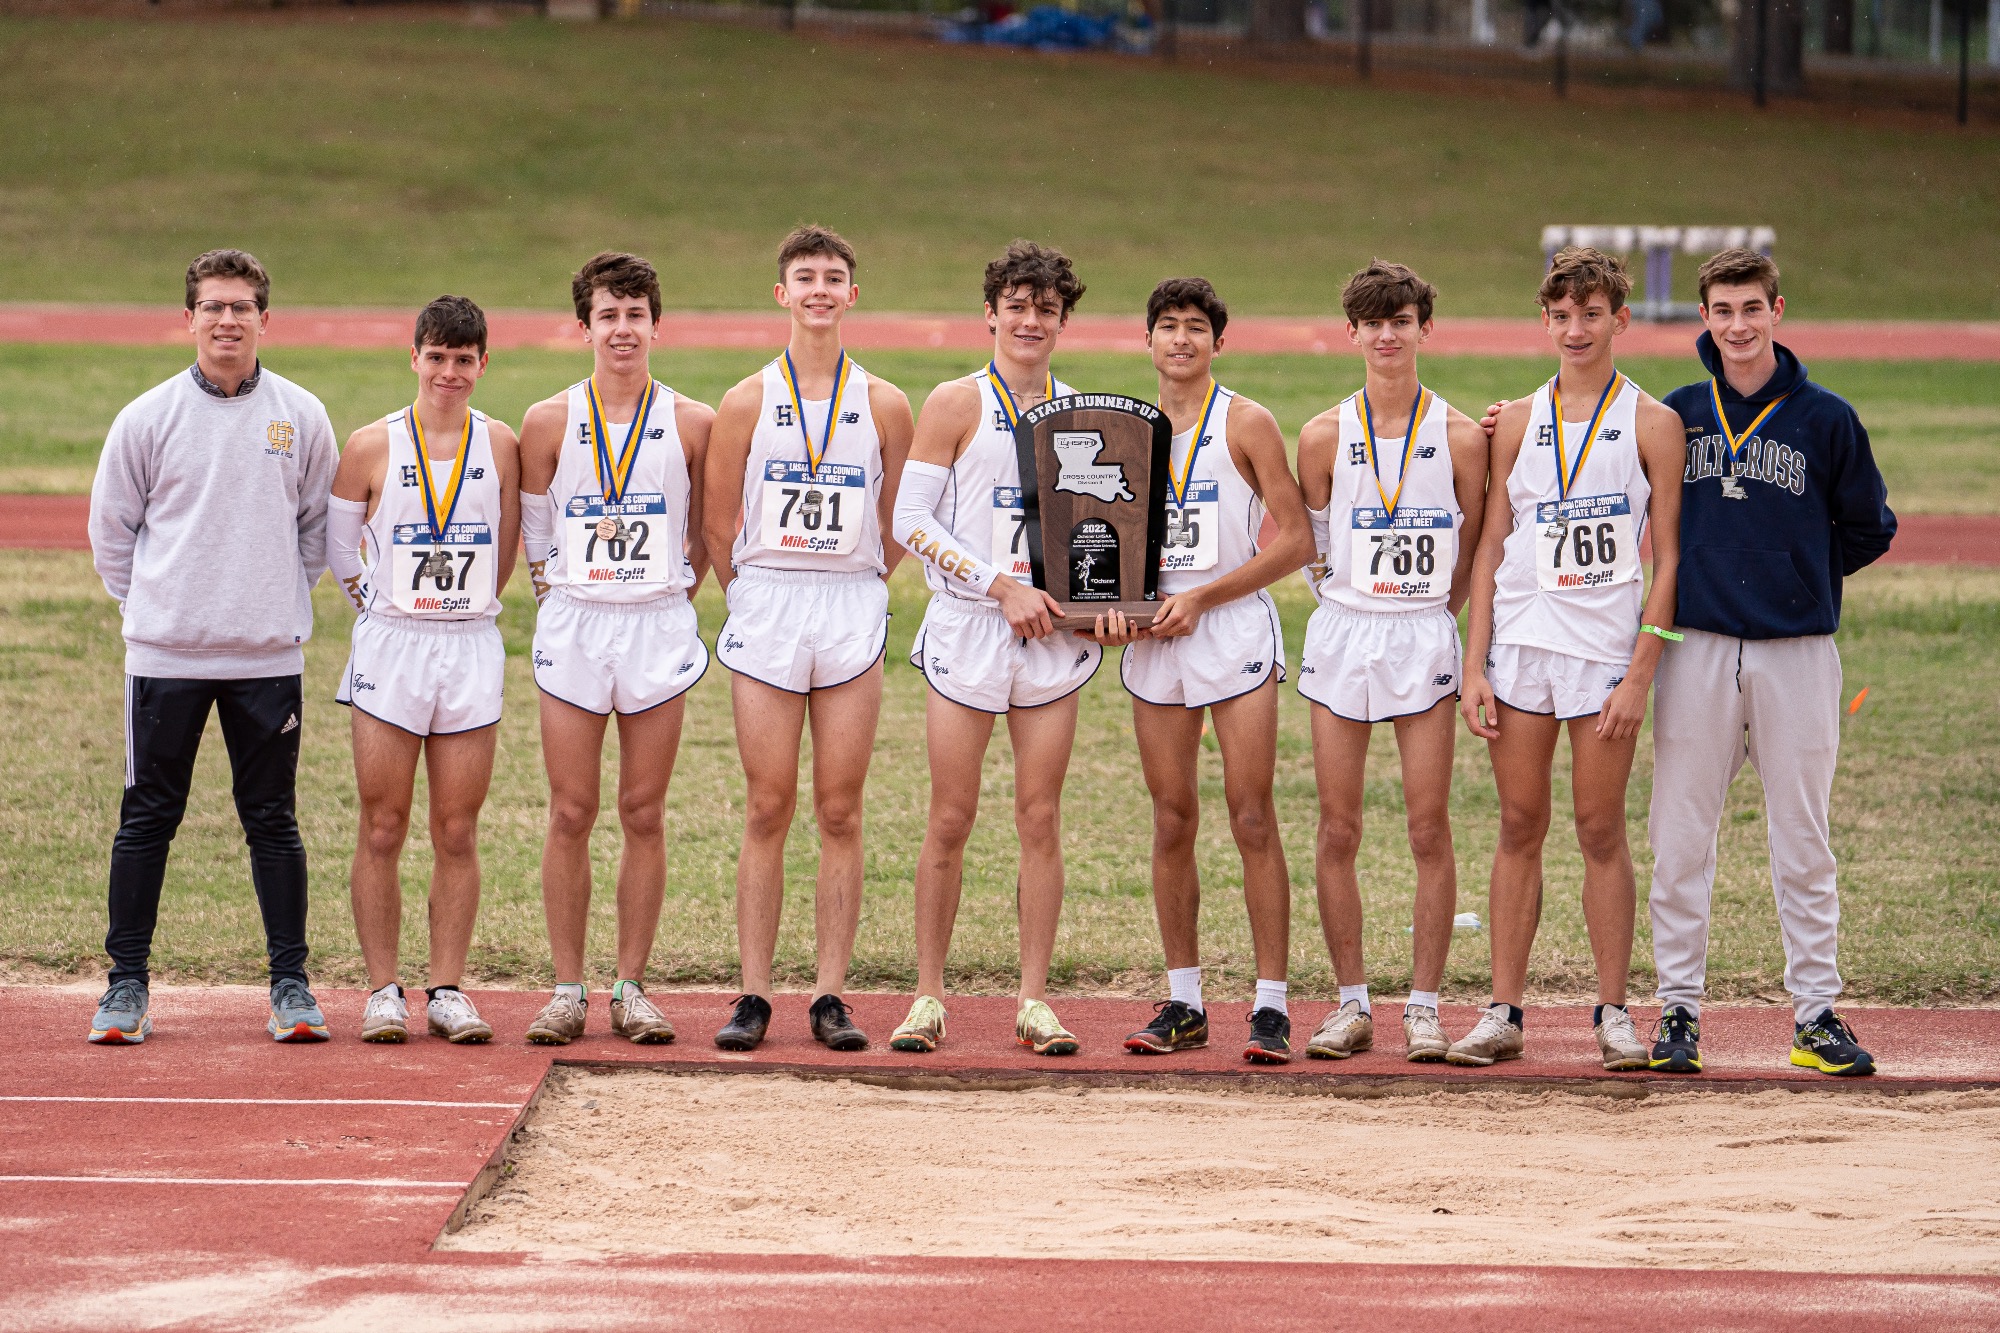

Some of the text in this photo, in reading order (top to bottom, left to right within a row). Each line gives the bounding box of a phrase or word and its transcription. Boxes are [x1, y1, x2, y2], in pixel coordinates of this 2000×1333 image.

[1026, 395, 1160, 424] STATE RUNNER-UP
[832, 465, 862, 477] COUNTRY
[825, 474, 847, 484] MEET
[589, 497, 605, 505] LHSA
[633, 494, 662, 504] COUNTRY
[1186, 491, 1200, 500] EET
[1574, 498, 1596, 508] CROSS
[1596, 495, 1625, 505] COUNTRY
[602, 504, 648, 514] STATE MEET
[780, 488, 843, 532] 761
[1397, 509, 1418, 518] CROSS
[1419, 508, 1448, 518] COUNTRY
[1568, 506, 1612, 519] STATE MEET
[461, 525, 488, 533] COUNTRY
[1082, 524, 1107, 533] 2022
[1162, 508, 1201, 549] 65
[1393, 518, 1434, 527] TATE MEET
[454, 534, 475, 543] MEET
[780, 535, 839, 552] MileSplit
[1553, 522, 1617, 568] 766
[906, 527, 977, 583] RAGE
[1160, 554, 1195, 570] eSplit
[1370, 534, 1435, 576] 768
[412, 551, 476, 591] 767
[588, 567, 646, 583] MileSplit
[1557, 569, 1614, 587] MileSplit
[1372, 582, 1431, 597] MileSplit
[413, 597, 471, 612] MileSplit
[533, 650, 554, 669] Tigers
[353, 673, 376, 692] Tigers
